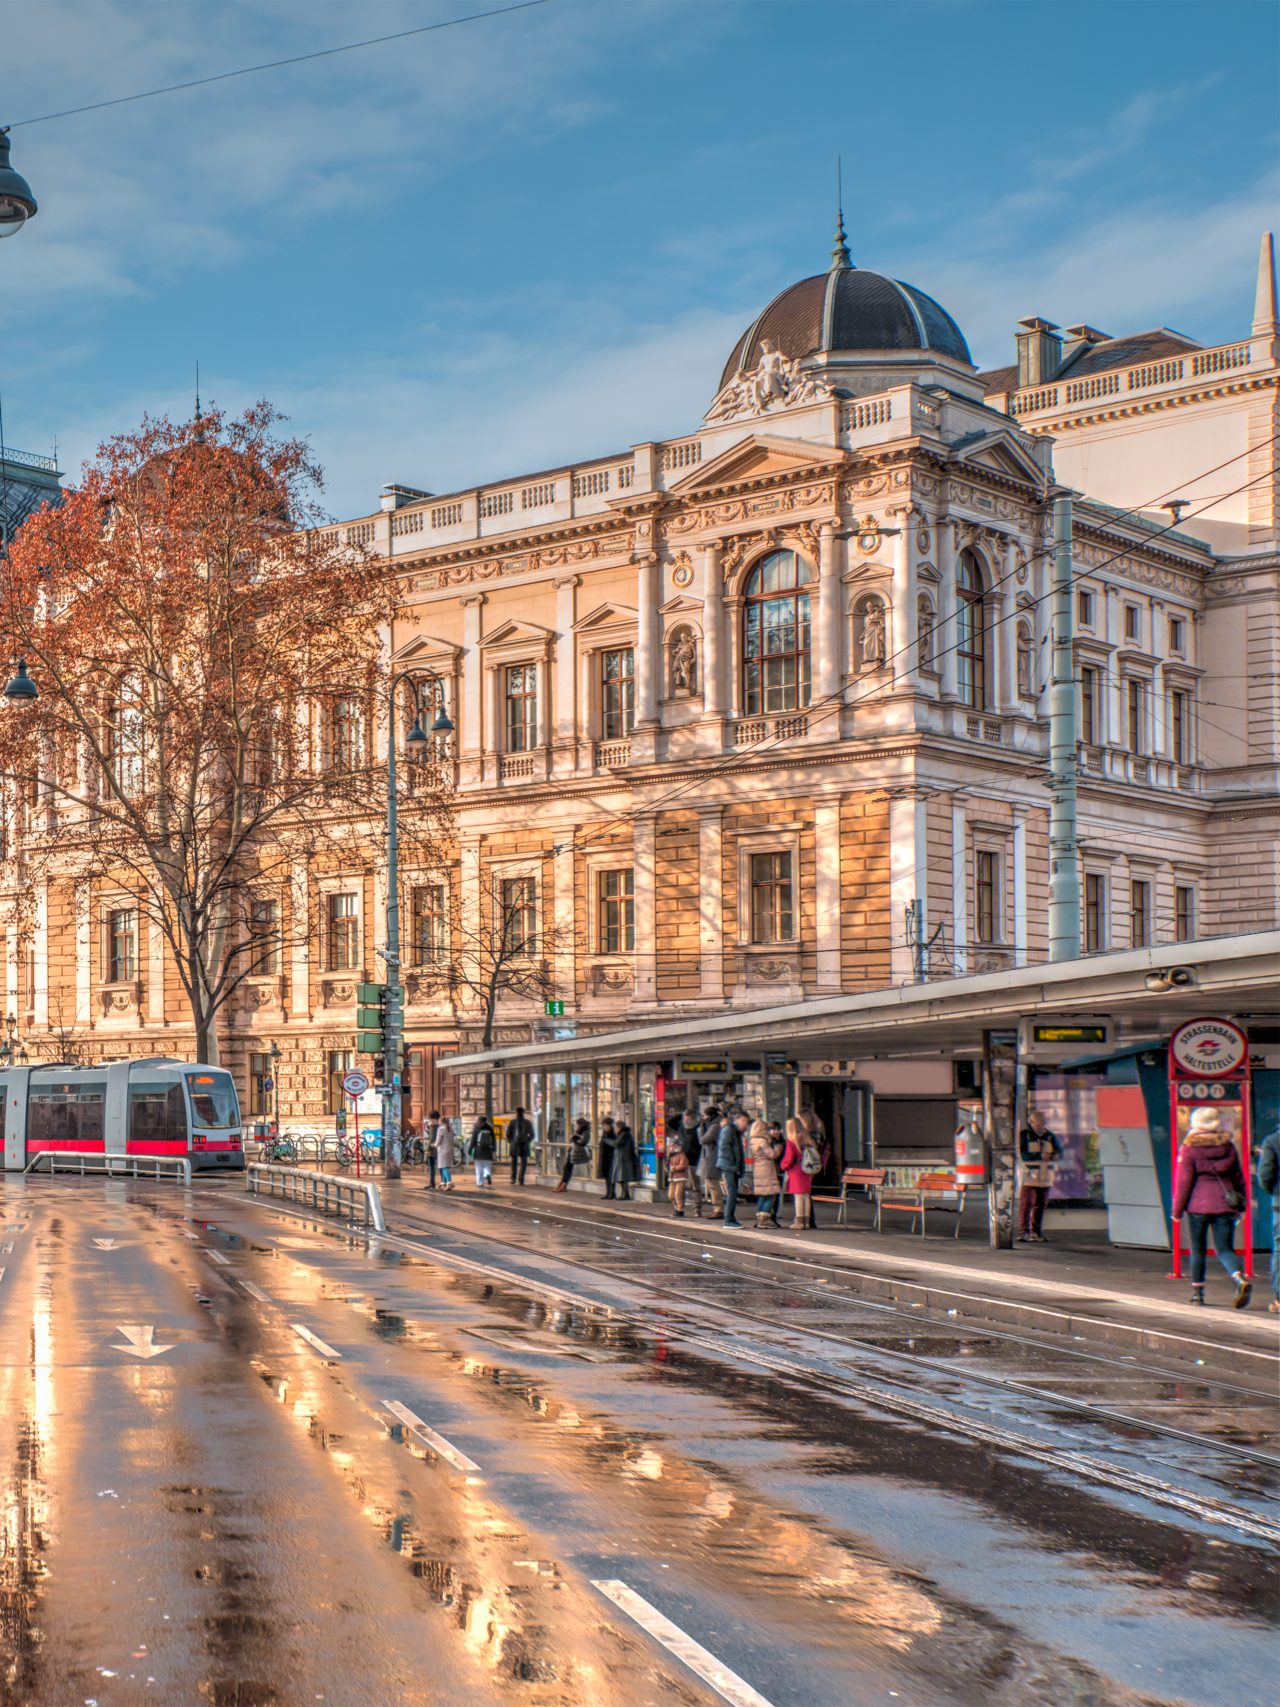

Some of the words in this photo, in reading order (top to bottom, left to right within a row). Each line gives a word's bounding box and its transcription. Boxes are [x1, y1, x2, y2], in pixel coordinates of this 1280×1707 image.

[1180, 1025, 1238, 1045] STRASSENBAHN
[1183, 1054, 1235, 1070] HALTESTELLE
[1213, 1087, 1222, 1095] 71
